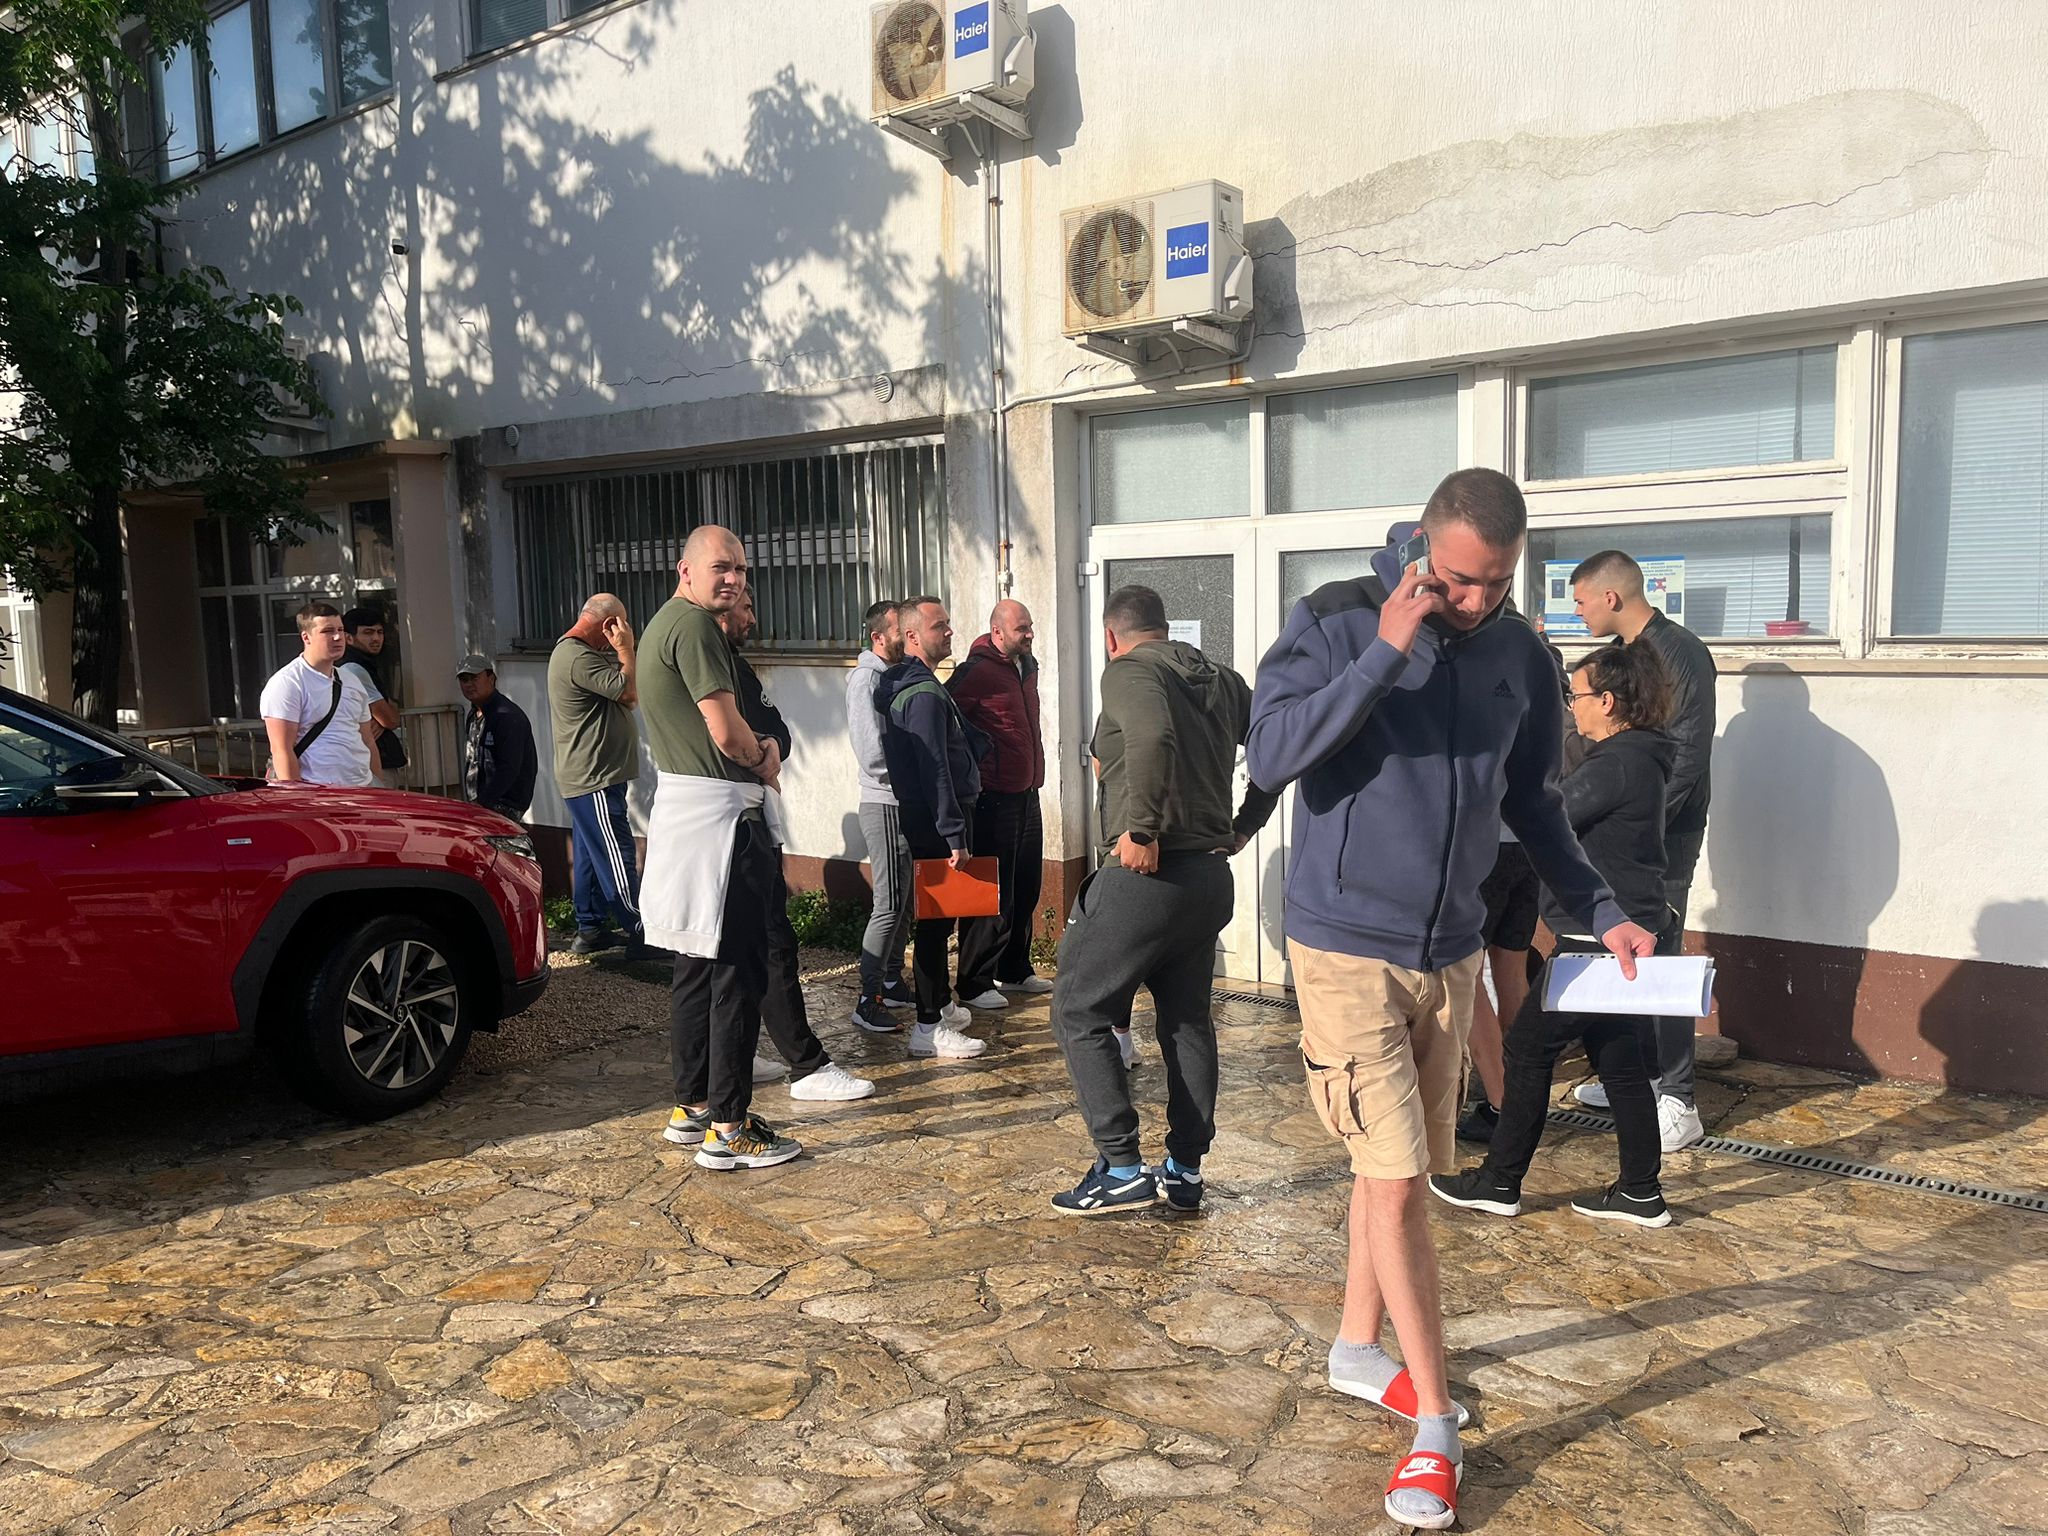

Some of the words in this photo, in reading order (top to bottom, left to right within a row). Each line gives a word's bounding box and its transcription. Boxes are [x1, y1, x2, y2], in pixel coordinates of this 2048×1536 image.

[956, 21, 987, 42] Haier
[1167, 242, 1207, 261] Haier
[1406, 1457, 1440, 1470] NIKE
